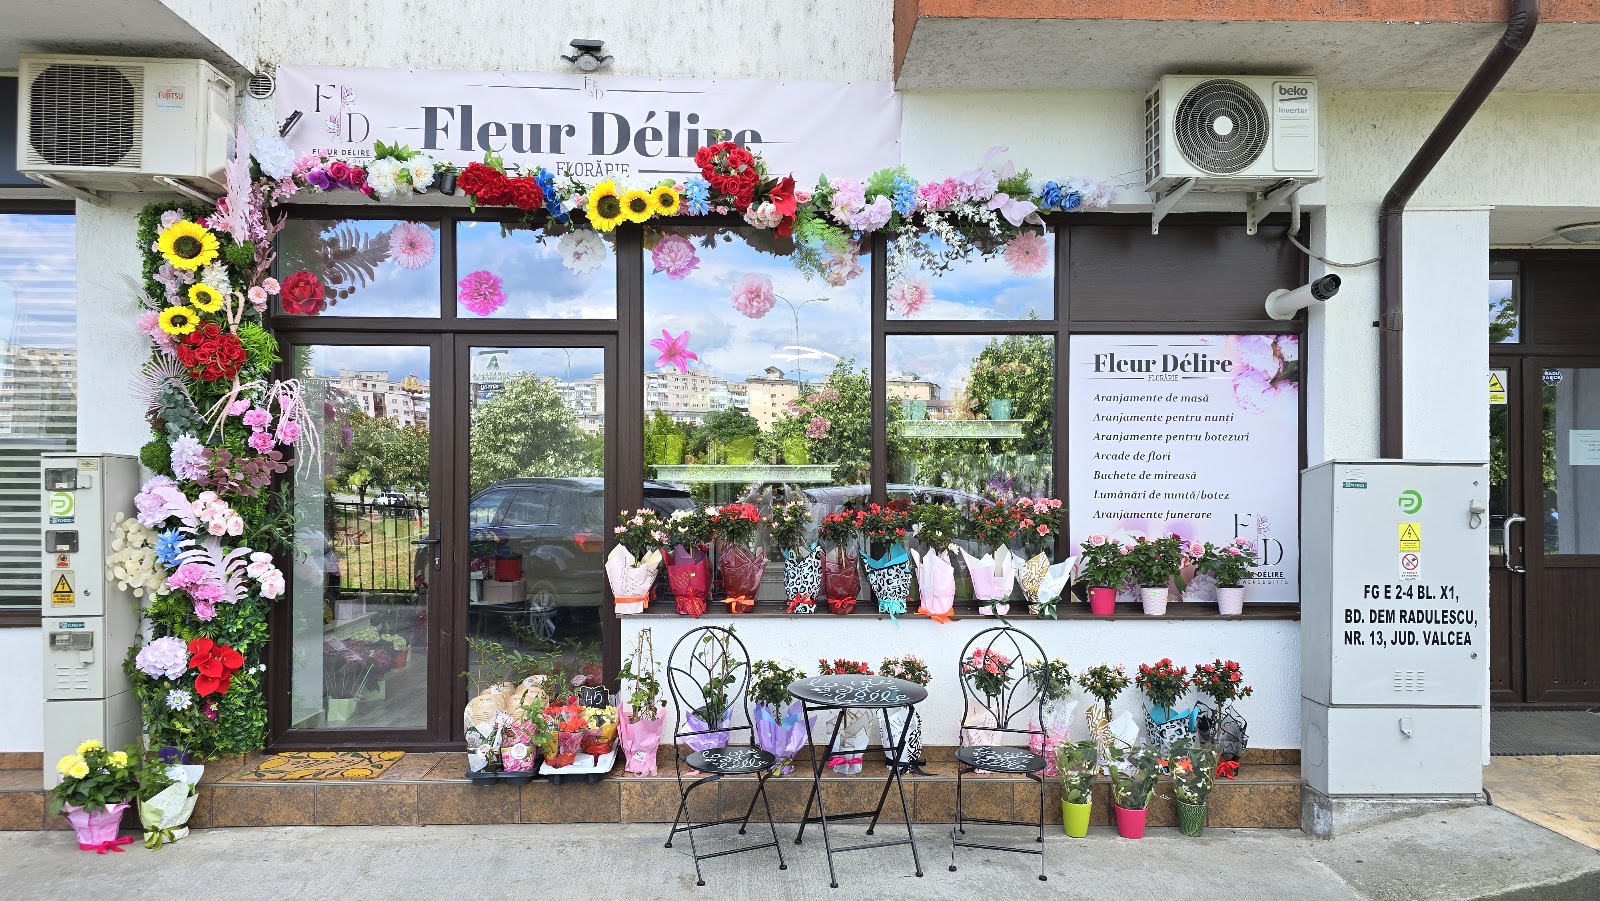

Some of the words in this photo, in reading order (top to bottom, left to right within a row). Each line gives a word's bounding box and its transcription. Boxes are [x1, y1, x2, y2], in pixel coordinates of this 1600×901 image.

[158, 90, 183, 100] FUJITSU
[1279, 85, 1308, 96] beko
[420, 104, 576, 154] Fleur
[341, 147, 371, 157] DÉLIRE
[1093, 353, 1156, 373] Fleur
[1160, 352, 1233, 373] Délire
[1093, 393, 1163, 404] Aranjamente
[1165, 393, 1178, 402] de
[1180, 394, 1209, 403] masă
[1092, 412, 1163, 424] Aranjamente
[1165, 413, 1202, 424] pentru
[1092, 432, 1163, 444] Aranjamente
[1165, 433, 1202, 443] pentru
[1204, 432, 1250, 442] botezuri
[1092, 451, 1131, 461] Arcade
[1132, 451, 1146, 461] de
[1146, 451, 1171, 463] flori
[1093, 470, 1136, 480] Buchete
[1138, 470, 1151, 480] de
[1153, 471, 1197, 480] mireasă
[1093, 489, 1146, 499] Lumânări
[1148, 490, 1162, 499] de
[1092, 510, 1163, 522] Aranjamente
[1164, 510, 1212, 522] funerare
[1363, 584, 1380, 600] FG
[1384, 584, 1391, 600] E
[1395, 584, 1414, 600] 2-4
[1417, 585, 1436, 600] BL.
[1440, 585, 1459, 602] X1,
[1344, 608, 1365, 624] BD.
[1369, 609, 1396, 624] DEM
[1399, 609, 1478, 627] RADULESCU,
[1344, 631, 1365, 646] NR.
[1369, 631, 1387, 649] 13,
[1390, 631, 1419, 646] JUD.
[1423, 631, 1472, 646] VALCEA
[585, 689, 603, 705] 45
